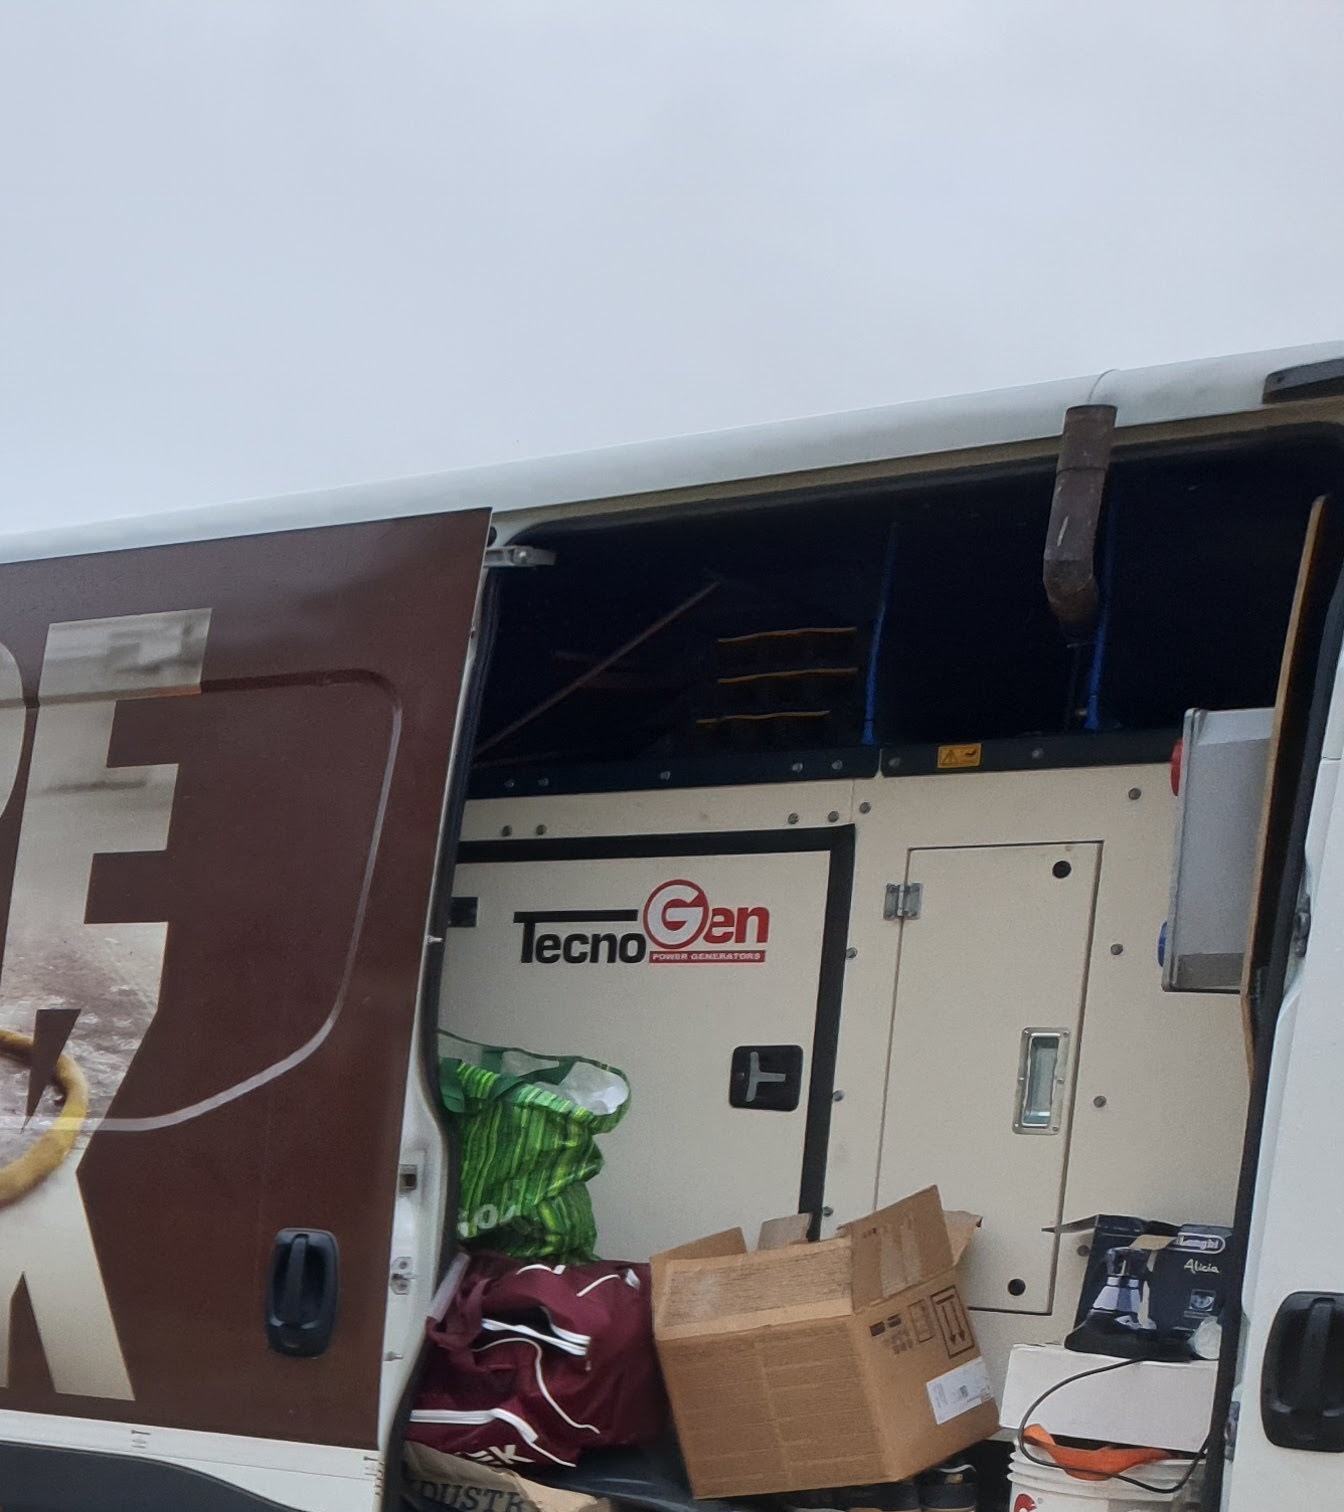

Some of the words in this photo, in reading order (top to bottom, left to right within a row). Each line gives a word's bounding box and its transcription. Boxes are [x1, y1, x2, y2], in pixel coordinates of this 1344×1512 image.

[513, 879, 770, 964] TecnoGen
[652, 953, 688, 961] POWER
[691, 952, 761, 961] GENERATORS
[1184, 1257, 1220, 1276] Alicia
